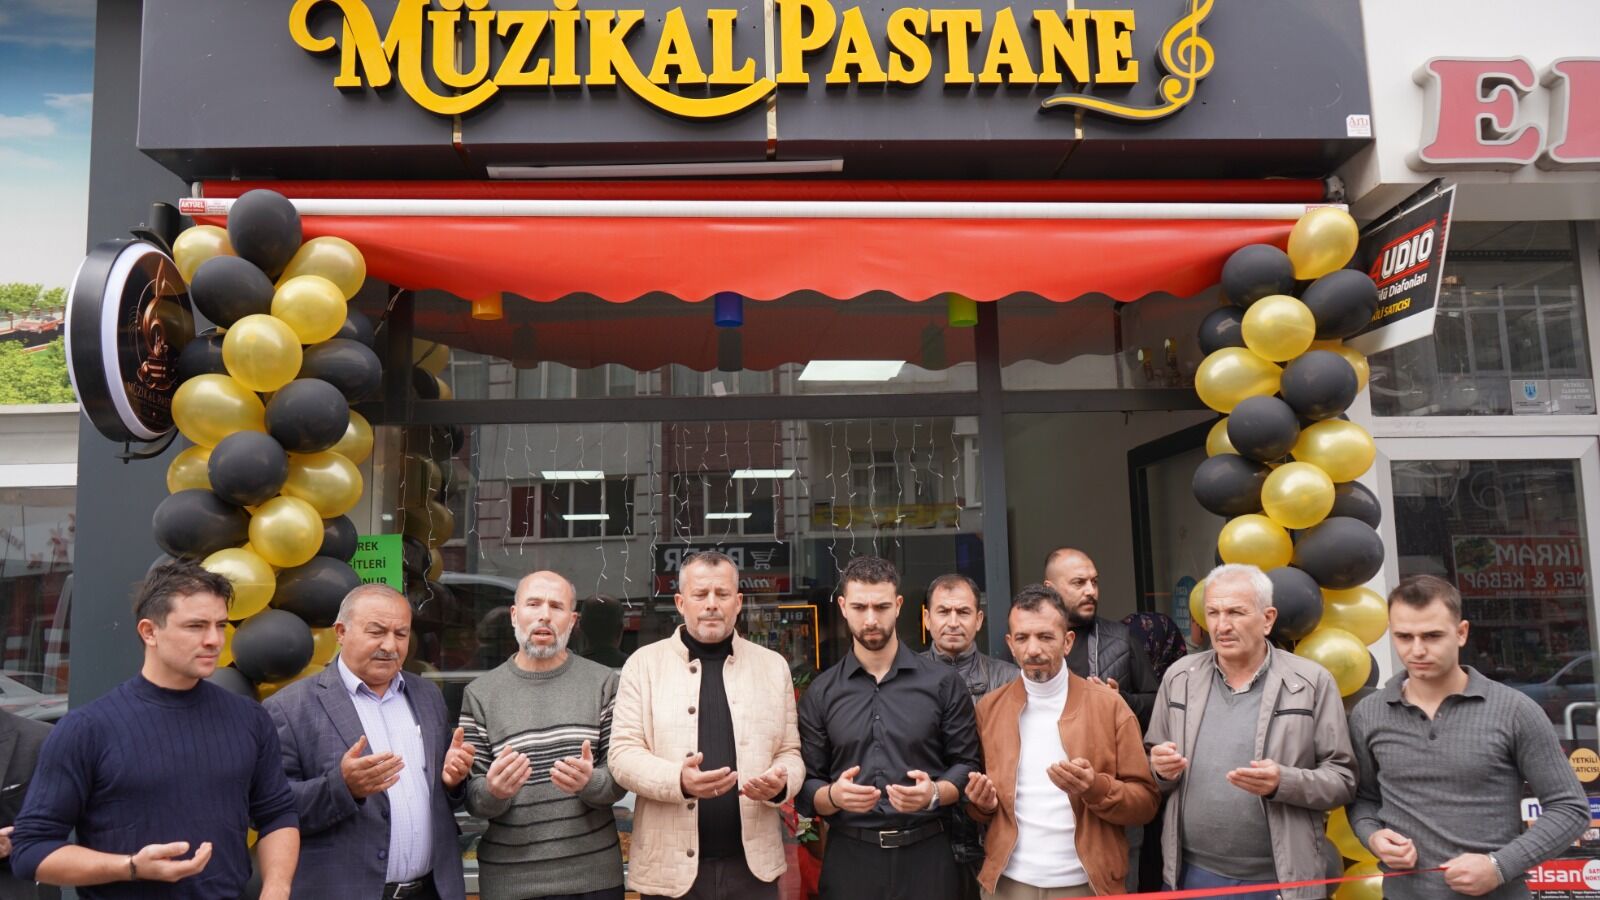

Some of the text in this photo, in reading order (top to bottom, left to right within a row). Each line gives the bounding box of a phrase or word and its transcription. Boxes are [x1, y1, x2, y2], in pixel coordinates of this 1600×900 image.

[289, 0, 1139, 117] MÜZİKAL PASTANE
[351, 557, 386, 569] İTLERİ
